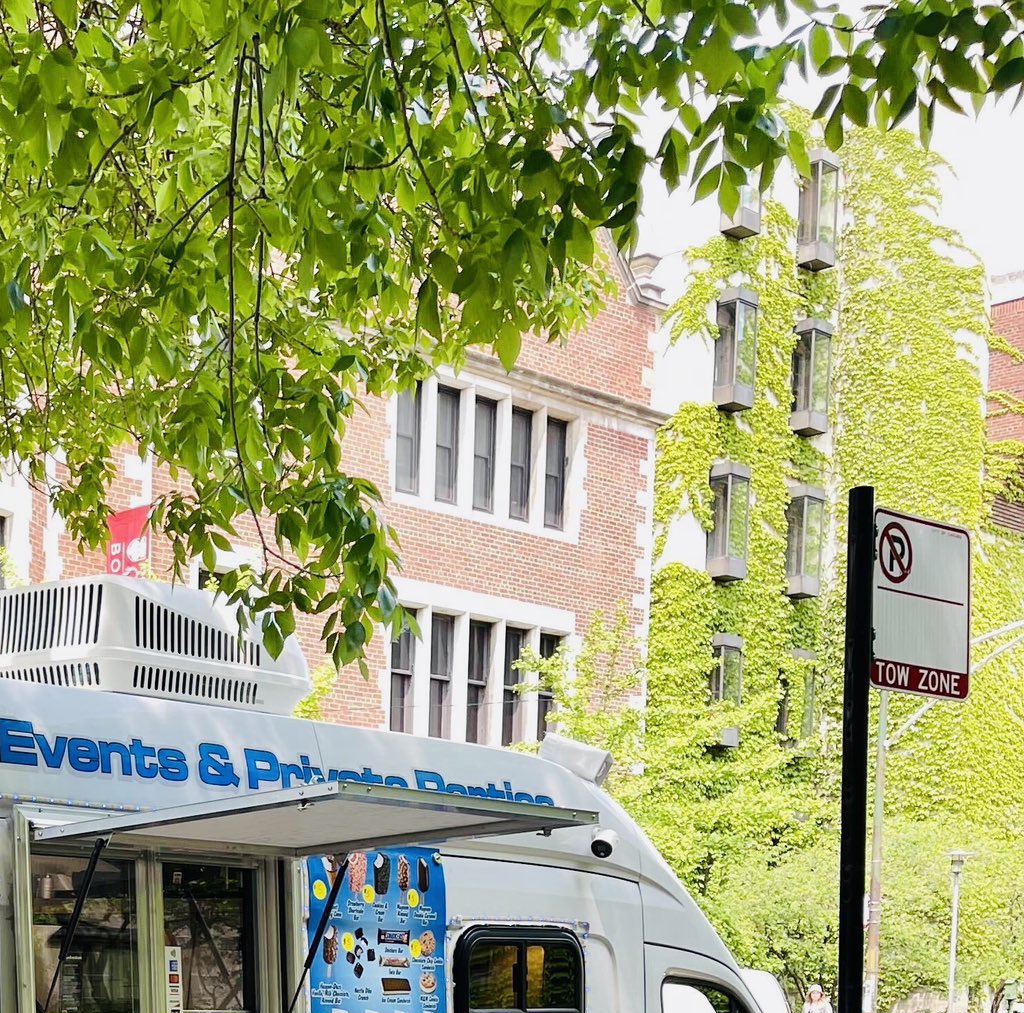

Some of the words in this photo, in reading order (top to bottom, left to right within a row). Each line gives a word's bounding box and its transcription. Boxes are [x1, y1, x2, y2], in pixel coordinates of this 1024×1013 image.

[875, 661, 910, 687] TOW
[918, 669, 961, 695] ZONE
[198, 742, 240, 789] &
